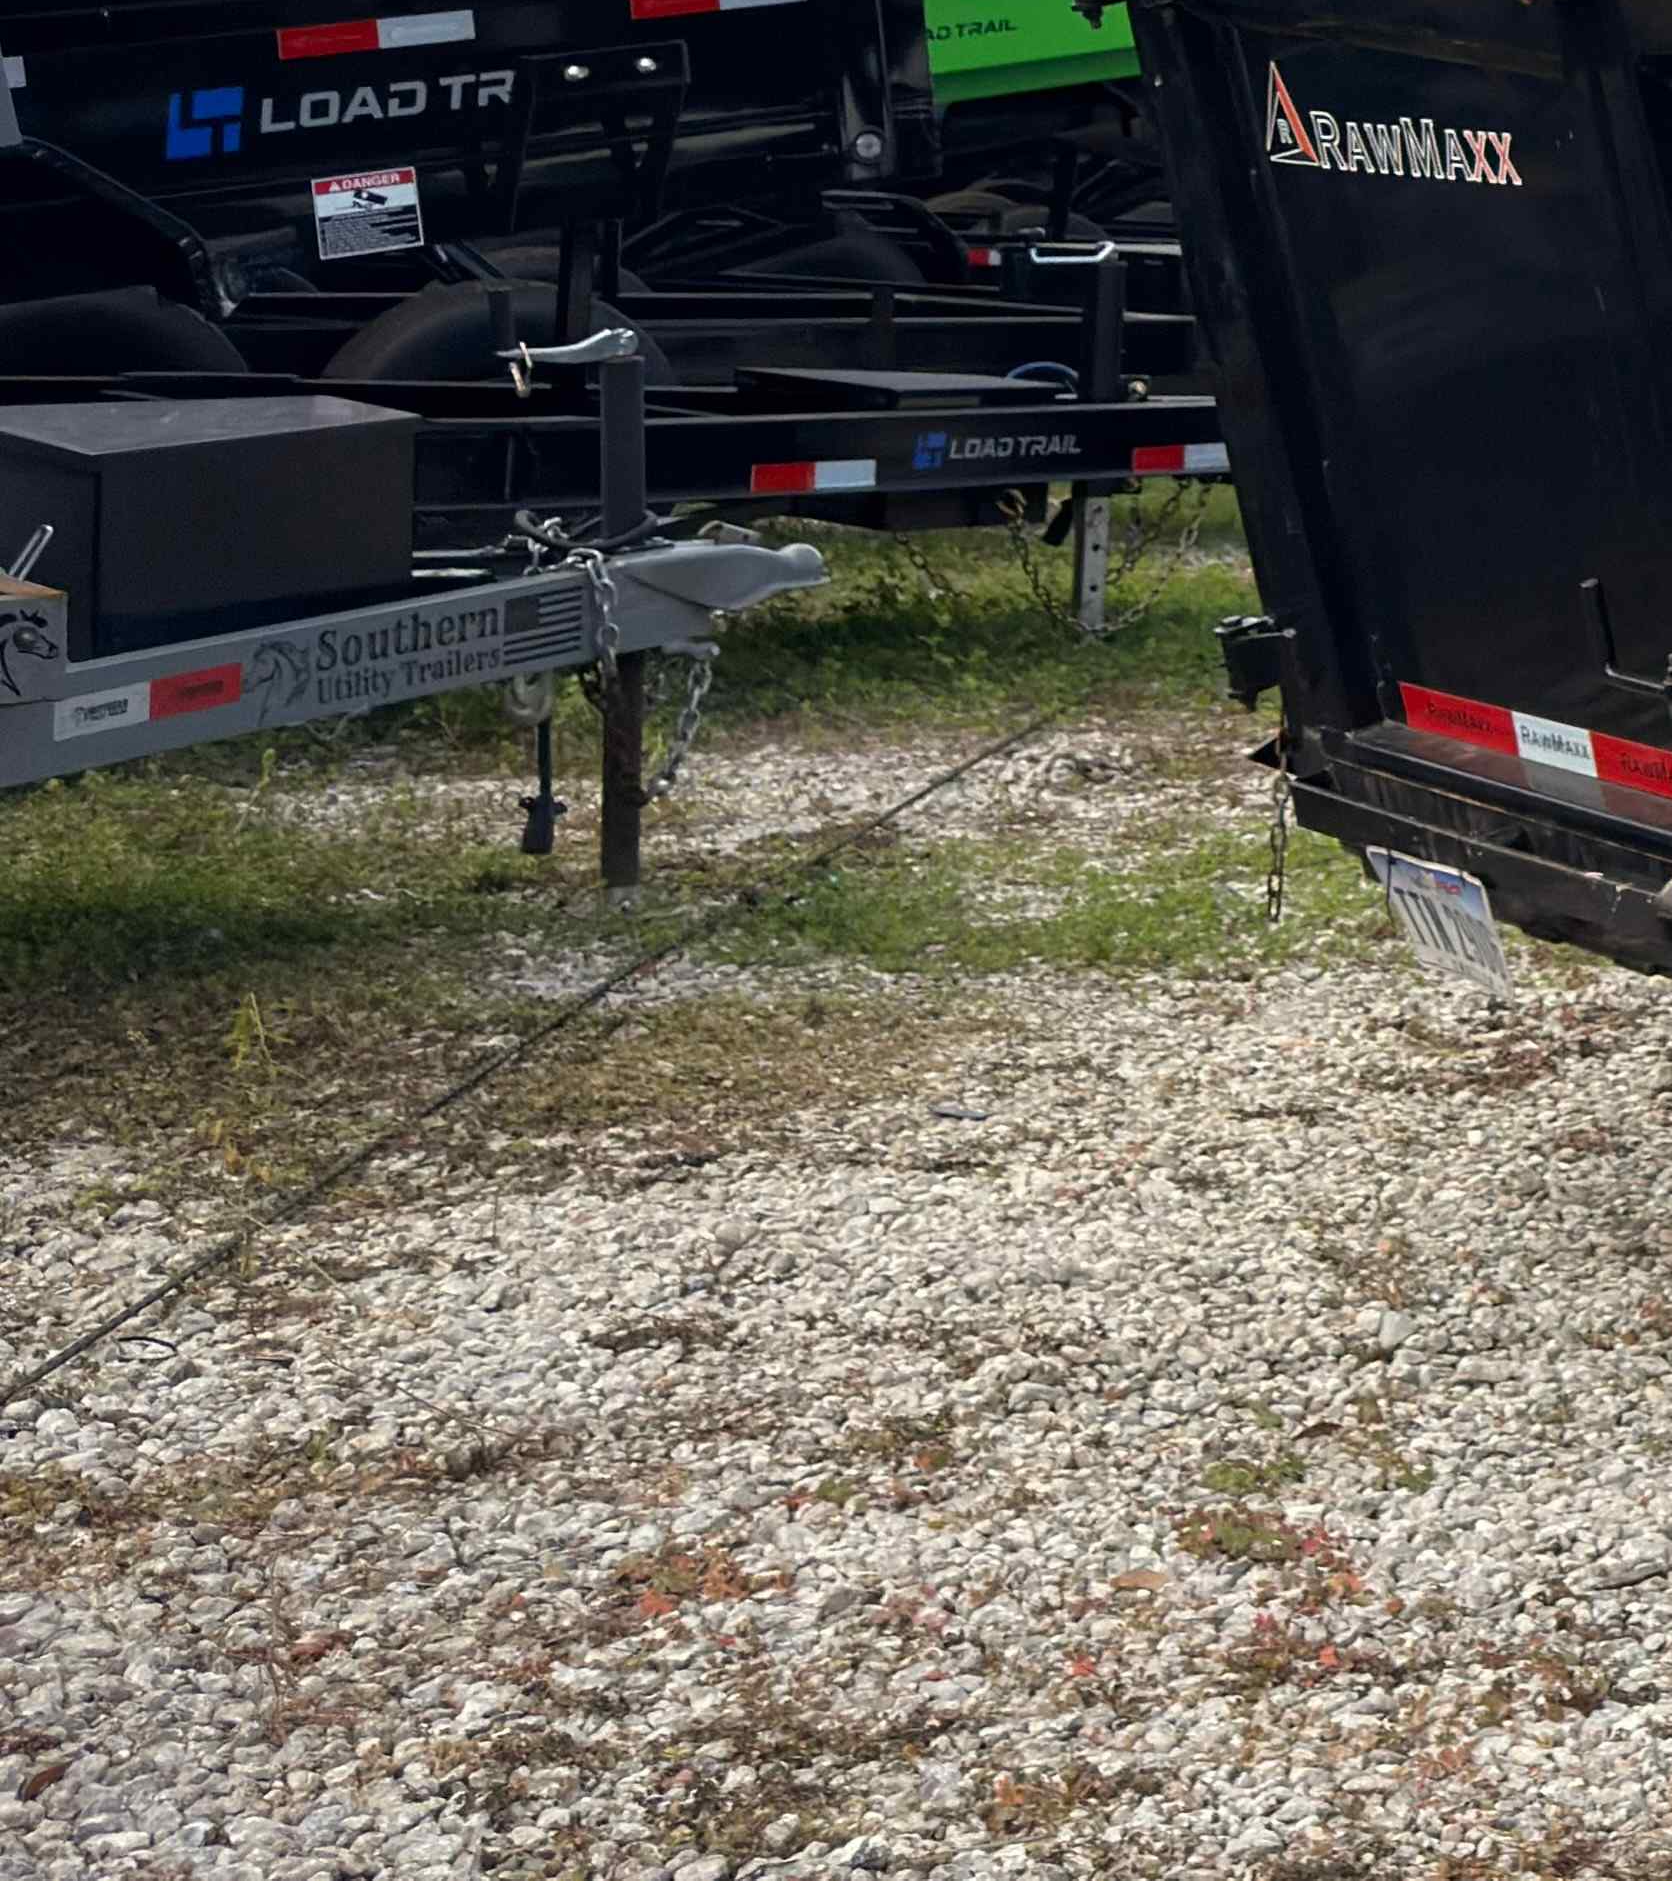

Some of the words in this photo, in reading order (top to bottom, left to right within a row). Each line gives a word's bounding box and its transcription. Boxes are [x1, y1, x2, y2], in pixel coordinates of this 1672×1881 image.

[955, 18, 1018, 39] TRAIL
[260, 80, 428, 134] LOAD
[342, 172, 400, 189] DANGER
[950, 437, 1014, 459] LOAD
[1017, 434, 1082, 456] TRAIL
[315, 607, 499, 671] Southern
[317, 668, 396, 704] Utility
[398, 648, 500, 686] Trailers
